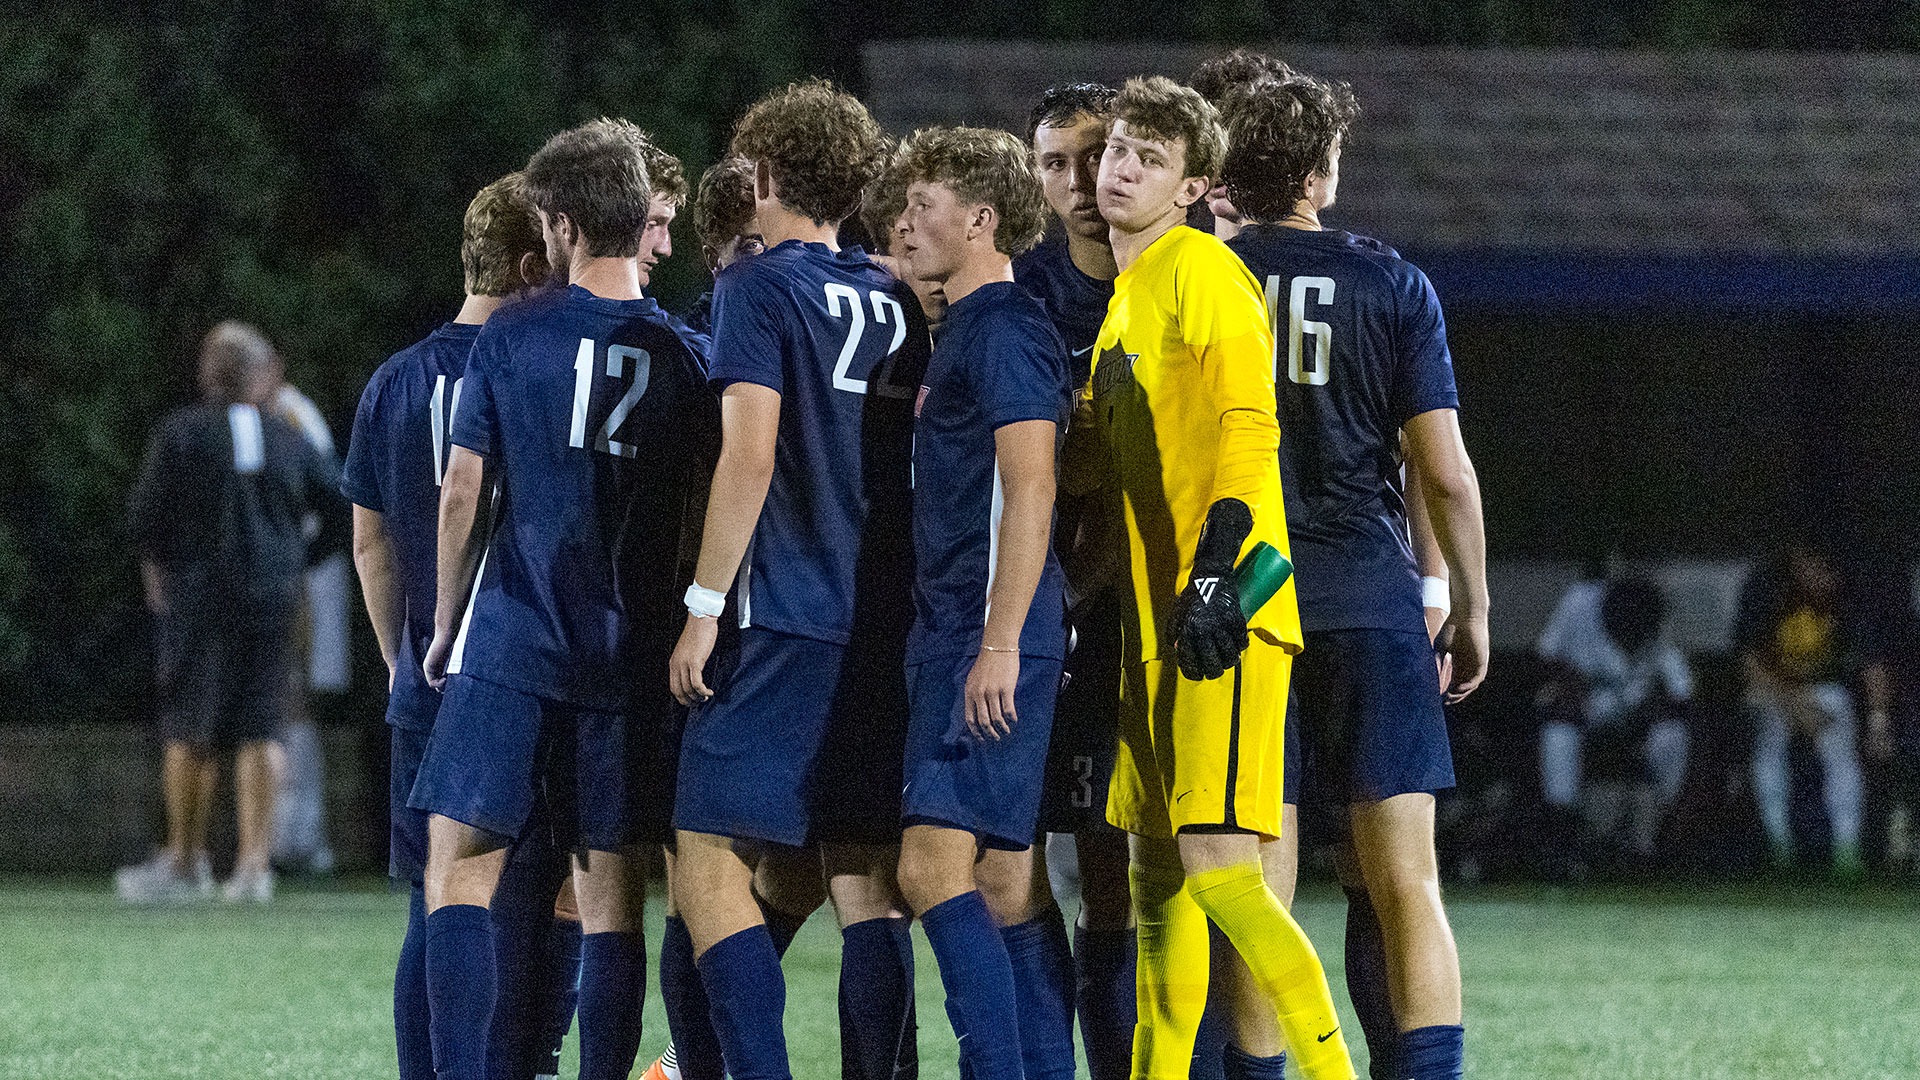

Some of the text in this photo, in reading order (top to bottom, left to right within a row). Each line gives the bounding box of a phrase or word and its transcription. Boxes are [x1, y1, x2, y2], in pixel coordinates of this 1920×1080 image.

[569, 338, 651, 459] 12
[824, 282, 913, 400] 22
[1071, 755, 1093, 808] 3
